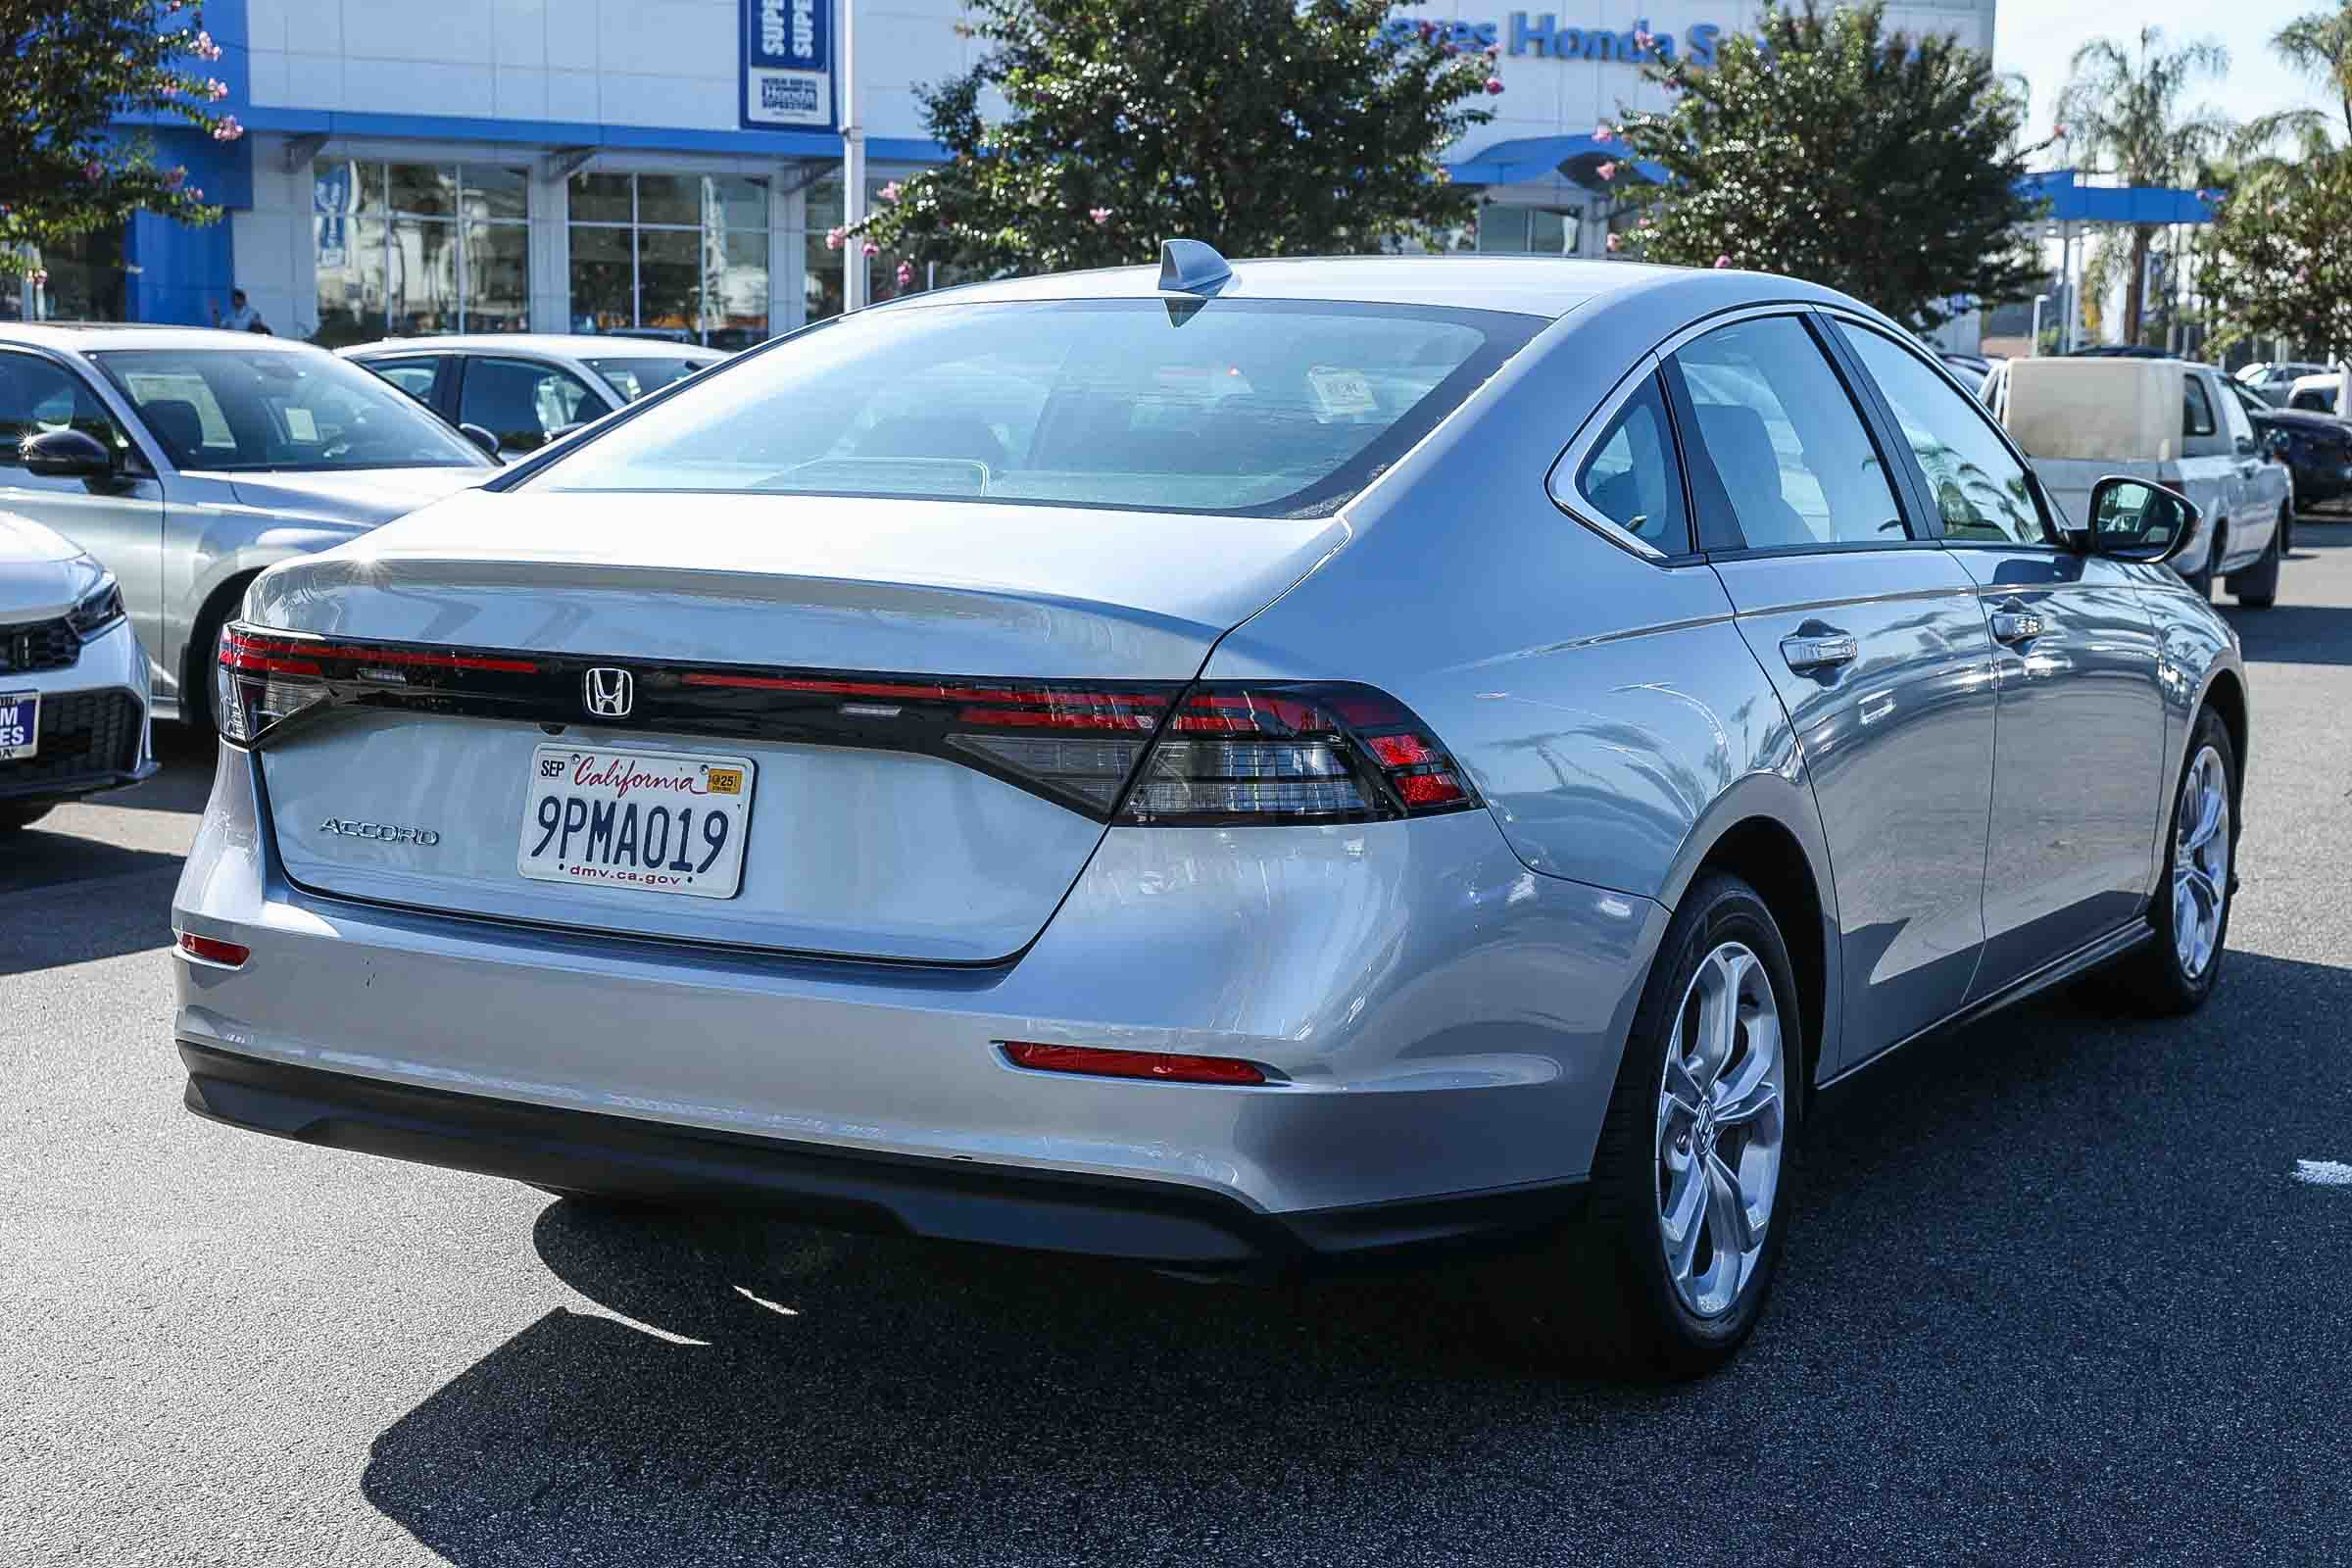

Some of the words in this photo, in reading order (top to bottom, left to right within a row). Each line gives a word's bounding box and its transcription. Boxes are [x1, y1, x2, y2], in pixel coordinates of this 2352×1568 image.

[1508, 11, 1675, 64] Honda
[540, 760, 565, 777] SEP
[573, 756, 708, 799] California
[319, 815, 439, 846] ACCORD
[530, 795, 729, 874] 9PMA019
[569, 864, 681, 886] dmv.ca.gov
